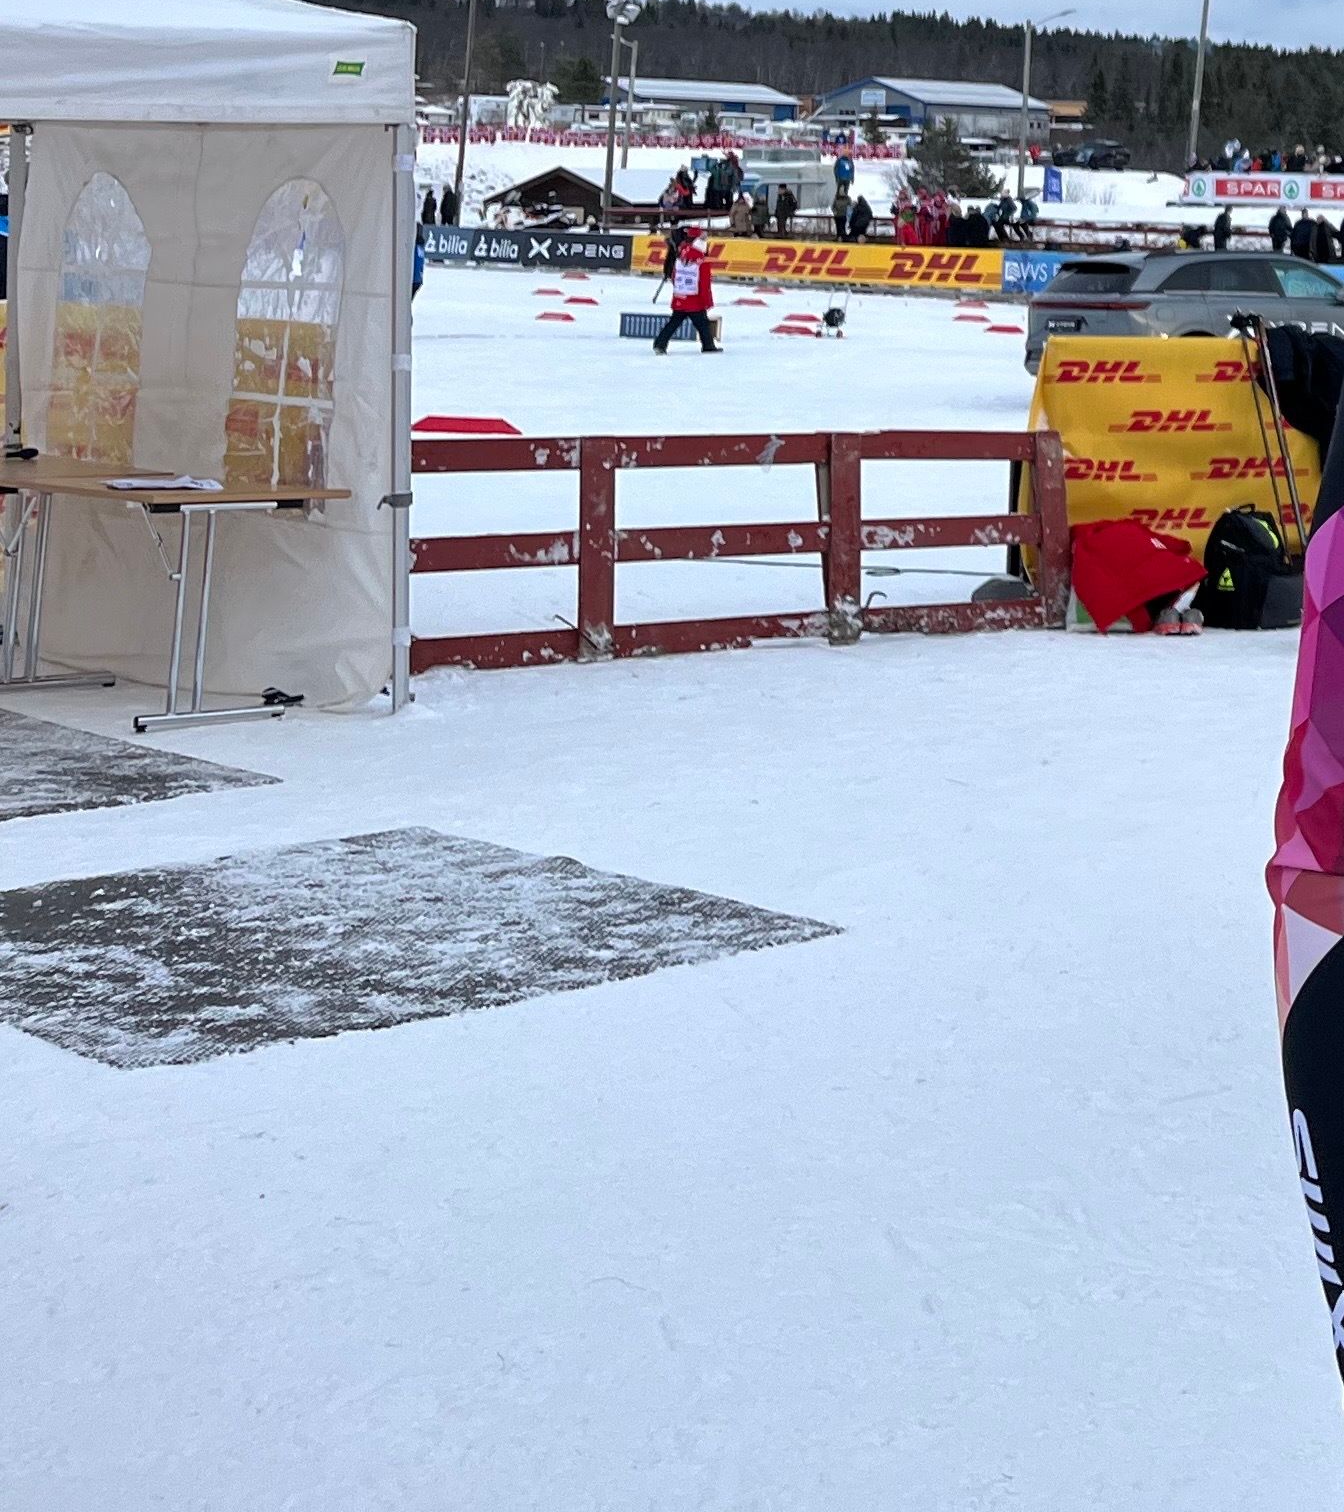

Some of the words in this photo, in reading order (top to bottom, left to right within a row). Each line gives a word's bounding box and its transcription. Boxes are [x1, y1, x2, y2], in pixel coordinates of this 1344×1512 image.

[1226, 181, 1280, 196] SPAR
[438, 234, 468, 255] bilia
[489, 237, 519, 259] bilia
[556, 242, 625, 259] XPENG
[648, 240, 729, 273] DL
[764, 245, 854, 277] DHL
[887, 251, 988, 284] DHL
[1056, 359, 1145, 383] DHL
[1126, 408, 1217, 433] DHL
[1064, 457, 1142, 482] DHL
[1207, 456, 1292, 481] DHL
